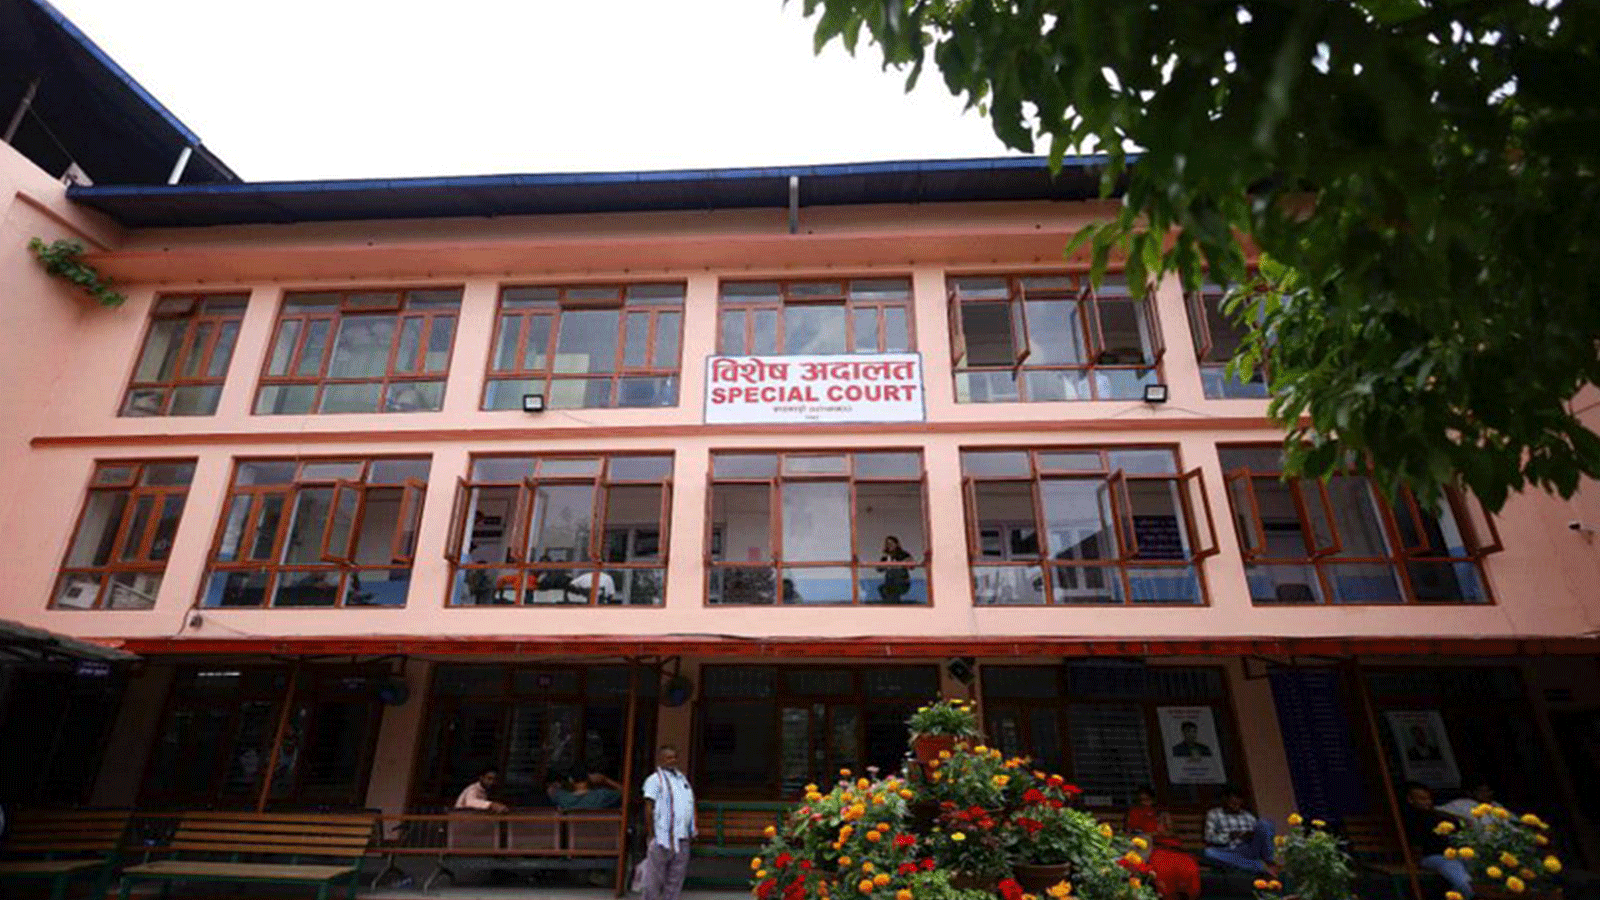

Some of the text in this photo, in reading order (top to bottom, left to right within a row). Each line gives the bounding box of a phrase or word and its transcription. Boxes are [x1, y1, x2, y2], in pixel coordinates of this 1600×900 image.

[712, 358, 915, 383] विशेष अदालत
[711, 385, 917, 404] SPECIAL COURT
